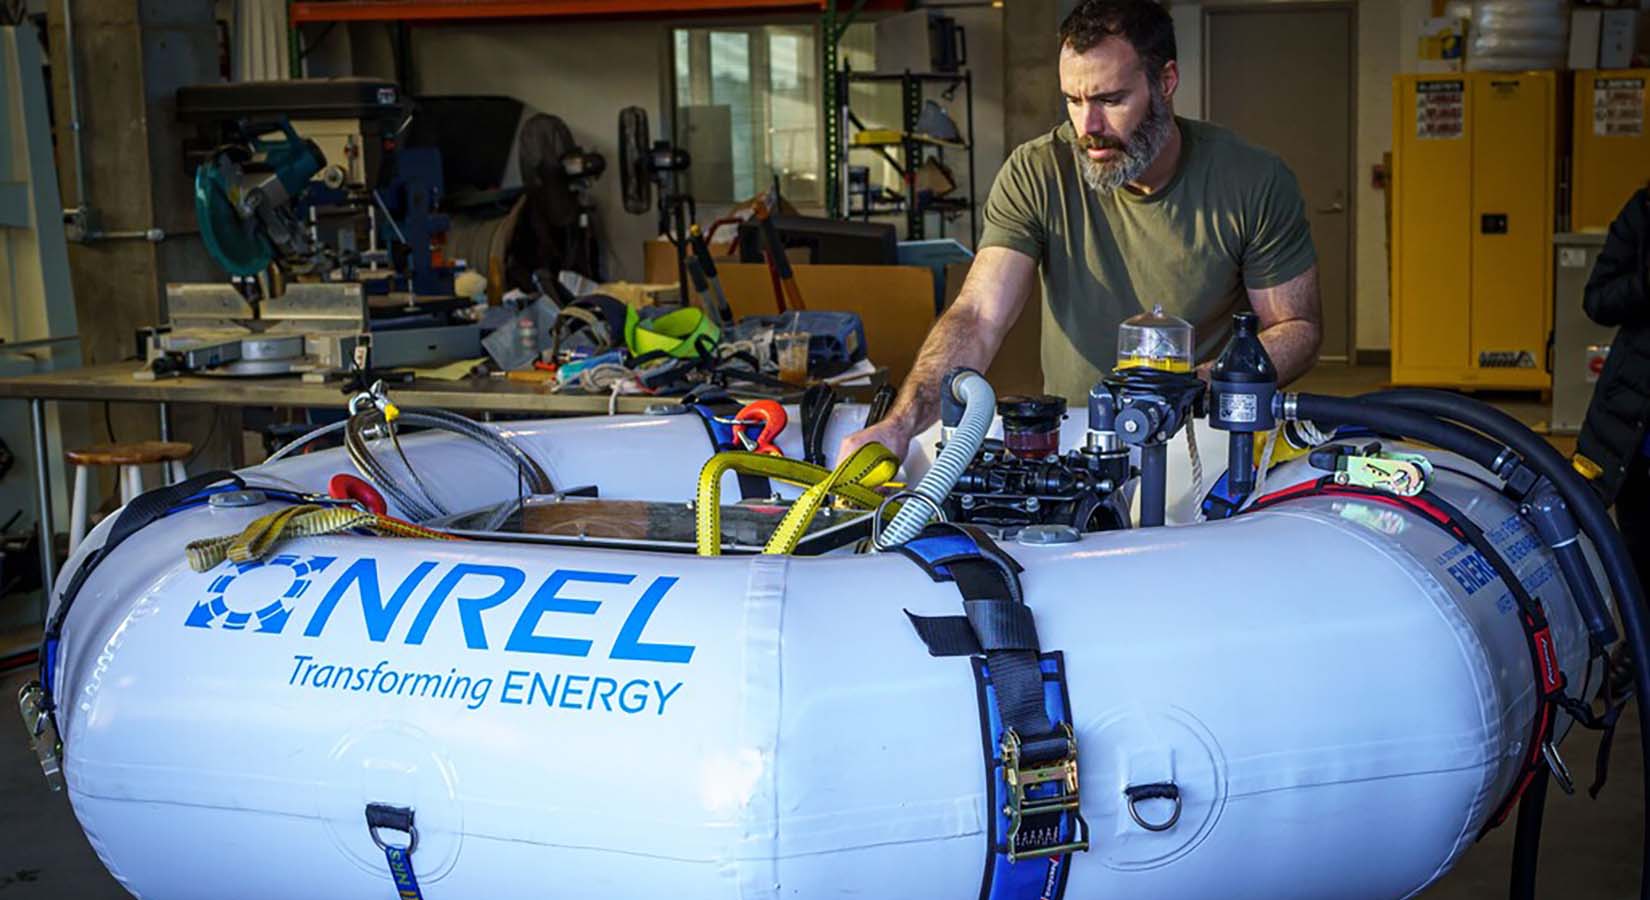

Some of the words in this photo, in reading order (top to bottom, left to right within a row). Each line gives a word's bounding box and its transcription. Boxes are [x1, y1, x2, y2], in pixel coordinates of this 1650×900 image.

[304, 557, 696, 664] NREL
[288, 655, 493, 709] Transforming
[500, 671, 683, 715] ENERGY
[389, 849, 411, 885] NRS
